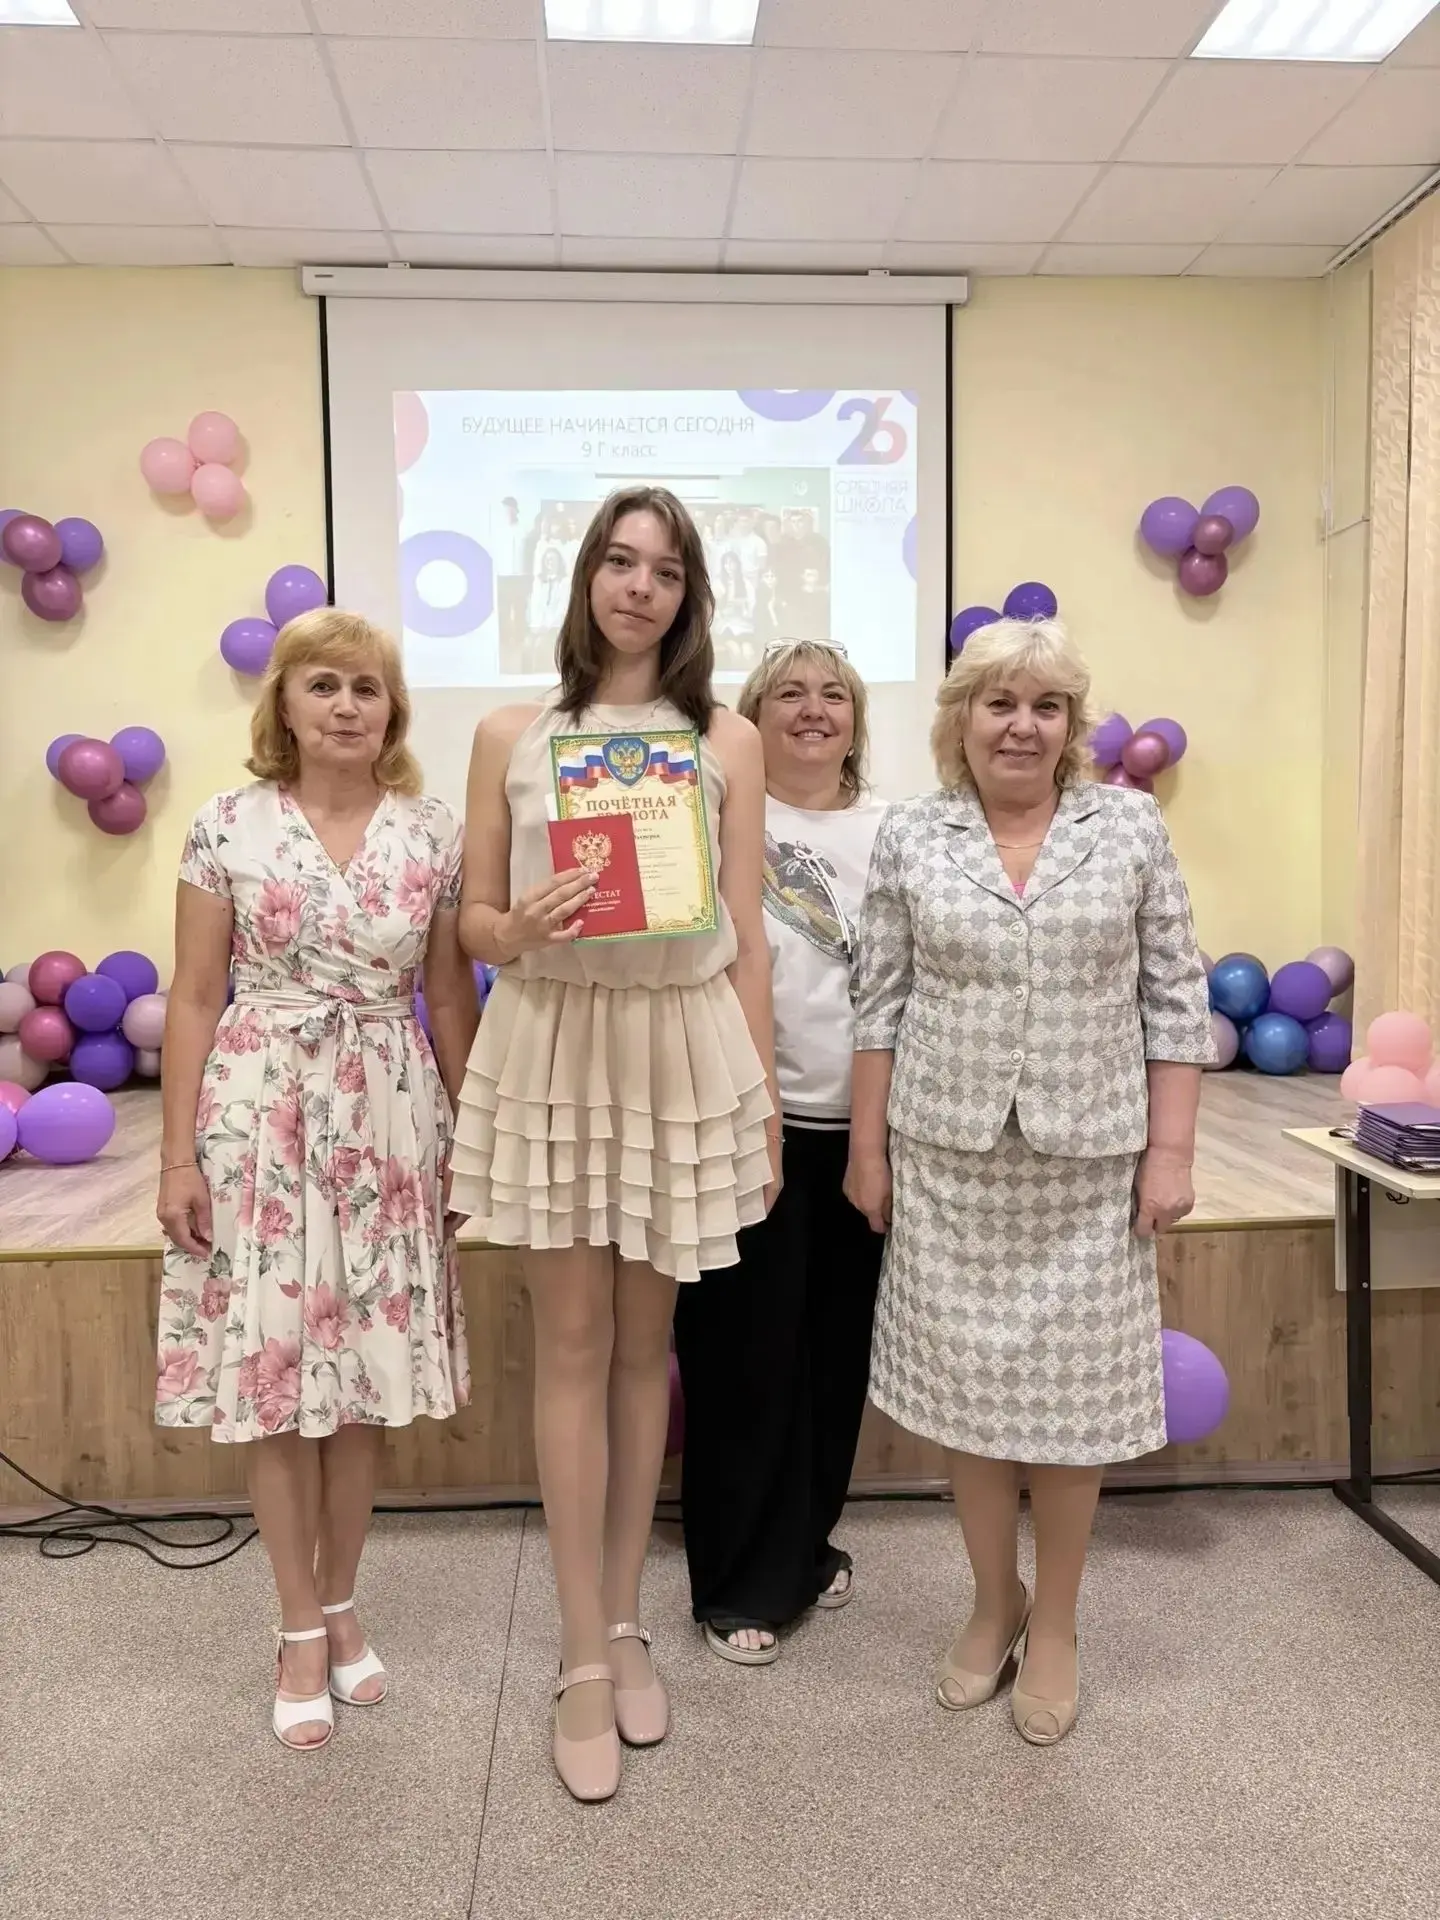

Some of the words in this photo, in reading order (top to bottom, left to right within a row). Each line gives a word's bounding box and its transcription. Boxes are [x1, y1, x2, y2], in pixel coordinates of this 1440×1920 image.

[462, 416, 545, 436] БУДУЩЕЕ
[551, 416, 668, 434] НАЧИНАЕТСЯ
[674, 416, 755, 436] СЕГОДНЯ
[836, 397, 908, 465] 26
[581, 440, 592, 458] 9
[598, 440, 606, 457] Г
[612, 444, 657, 458] класс
[836, 496, 909, 514] ШКОЛА
[586, 796, 677, 812] ПОЧЁТНАЯ
